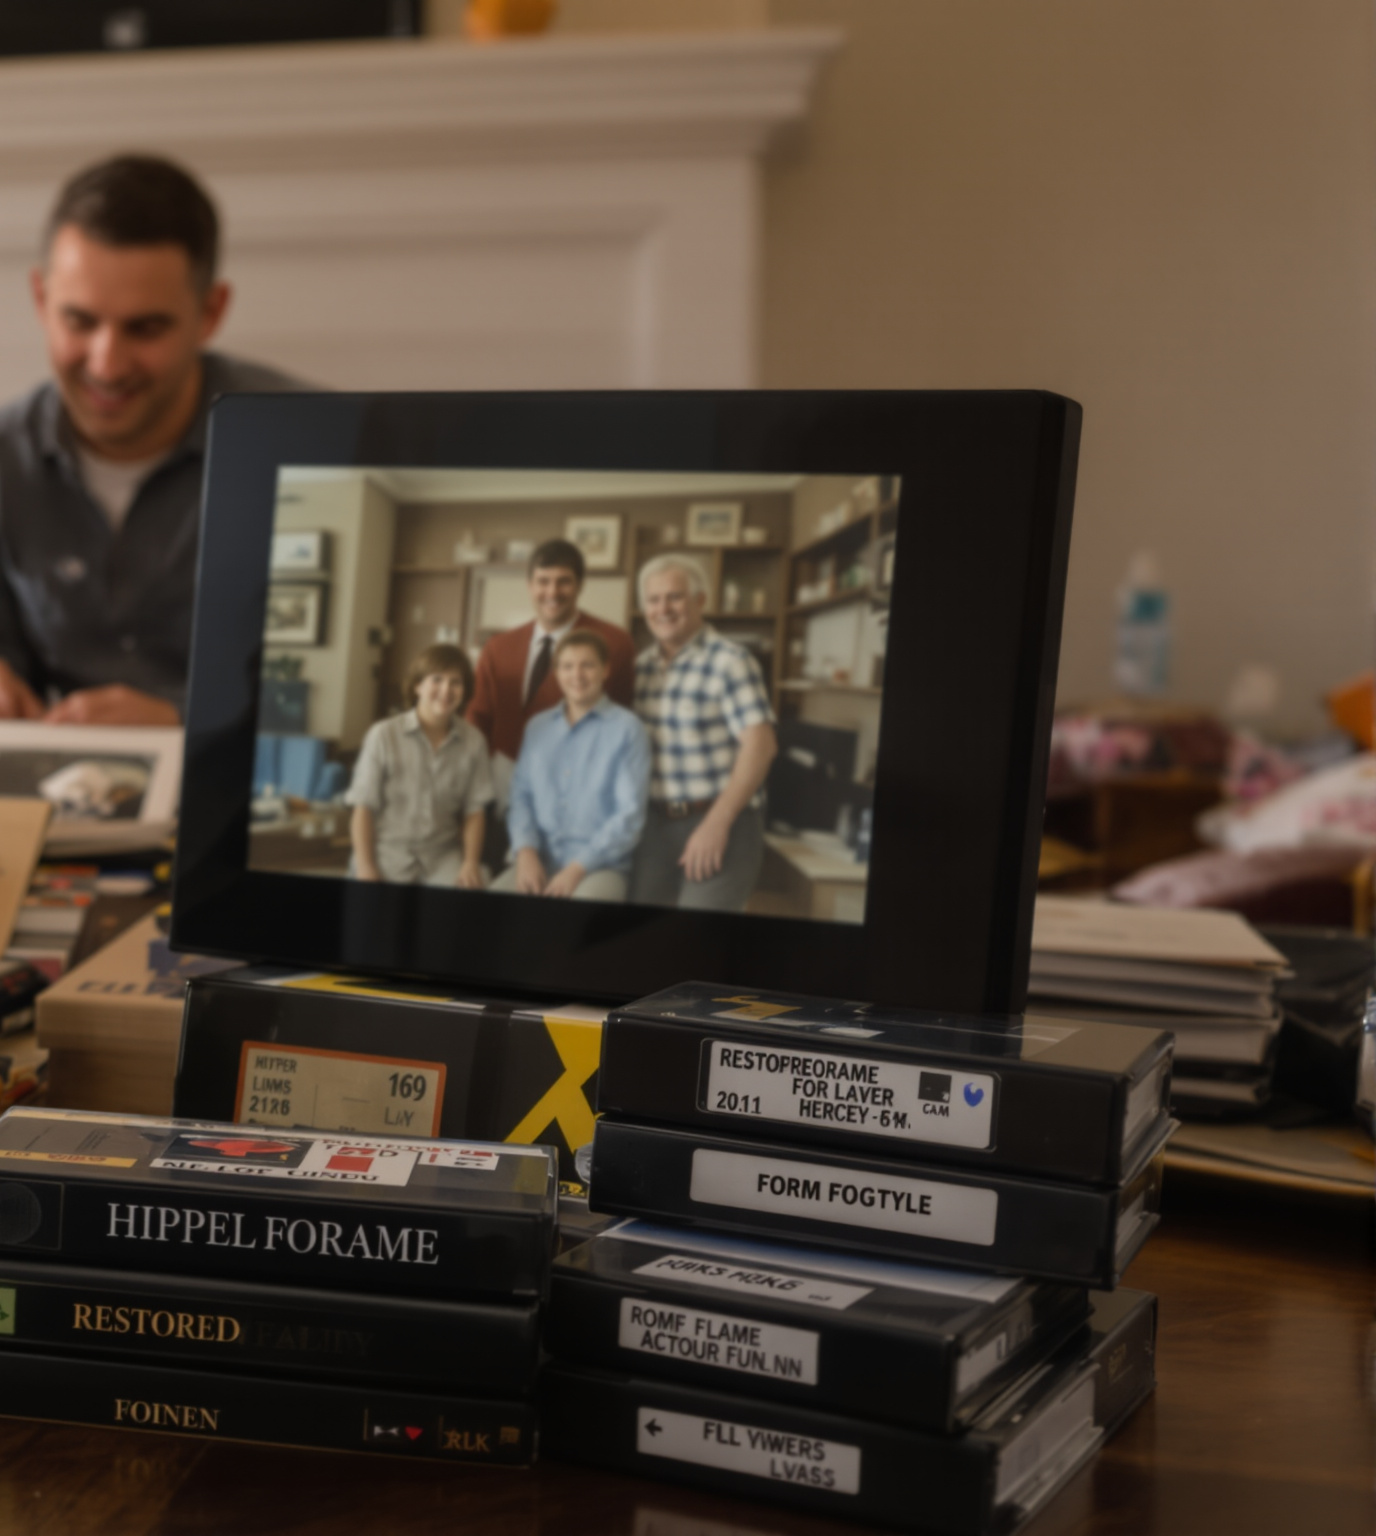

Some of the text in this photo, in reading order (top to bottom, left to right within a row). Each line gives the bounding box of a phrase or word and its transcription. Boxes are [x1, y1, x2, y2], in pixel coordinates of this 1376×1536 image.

[389, 1072, 427, 1101] 169
[792, 1078, 894, 1107] FOR LAVER
[799, 1098, 869, 1124] HERCEY
[922, 1103, 950, 1117] CAM
[757, 1174, 932, 1215] FORM FOGTYLE
[107, 1203, 440, 1265] HIPPEL FORAME
[72, 1303, 241, 1343] RESTORED
[695, 1318, 761, 1347] FLAME
[640, 1330, 719, 1362] ACTOUR
[115, 1399, 220, 1431] FOINEN
